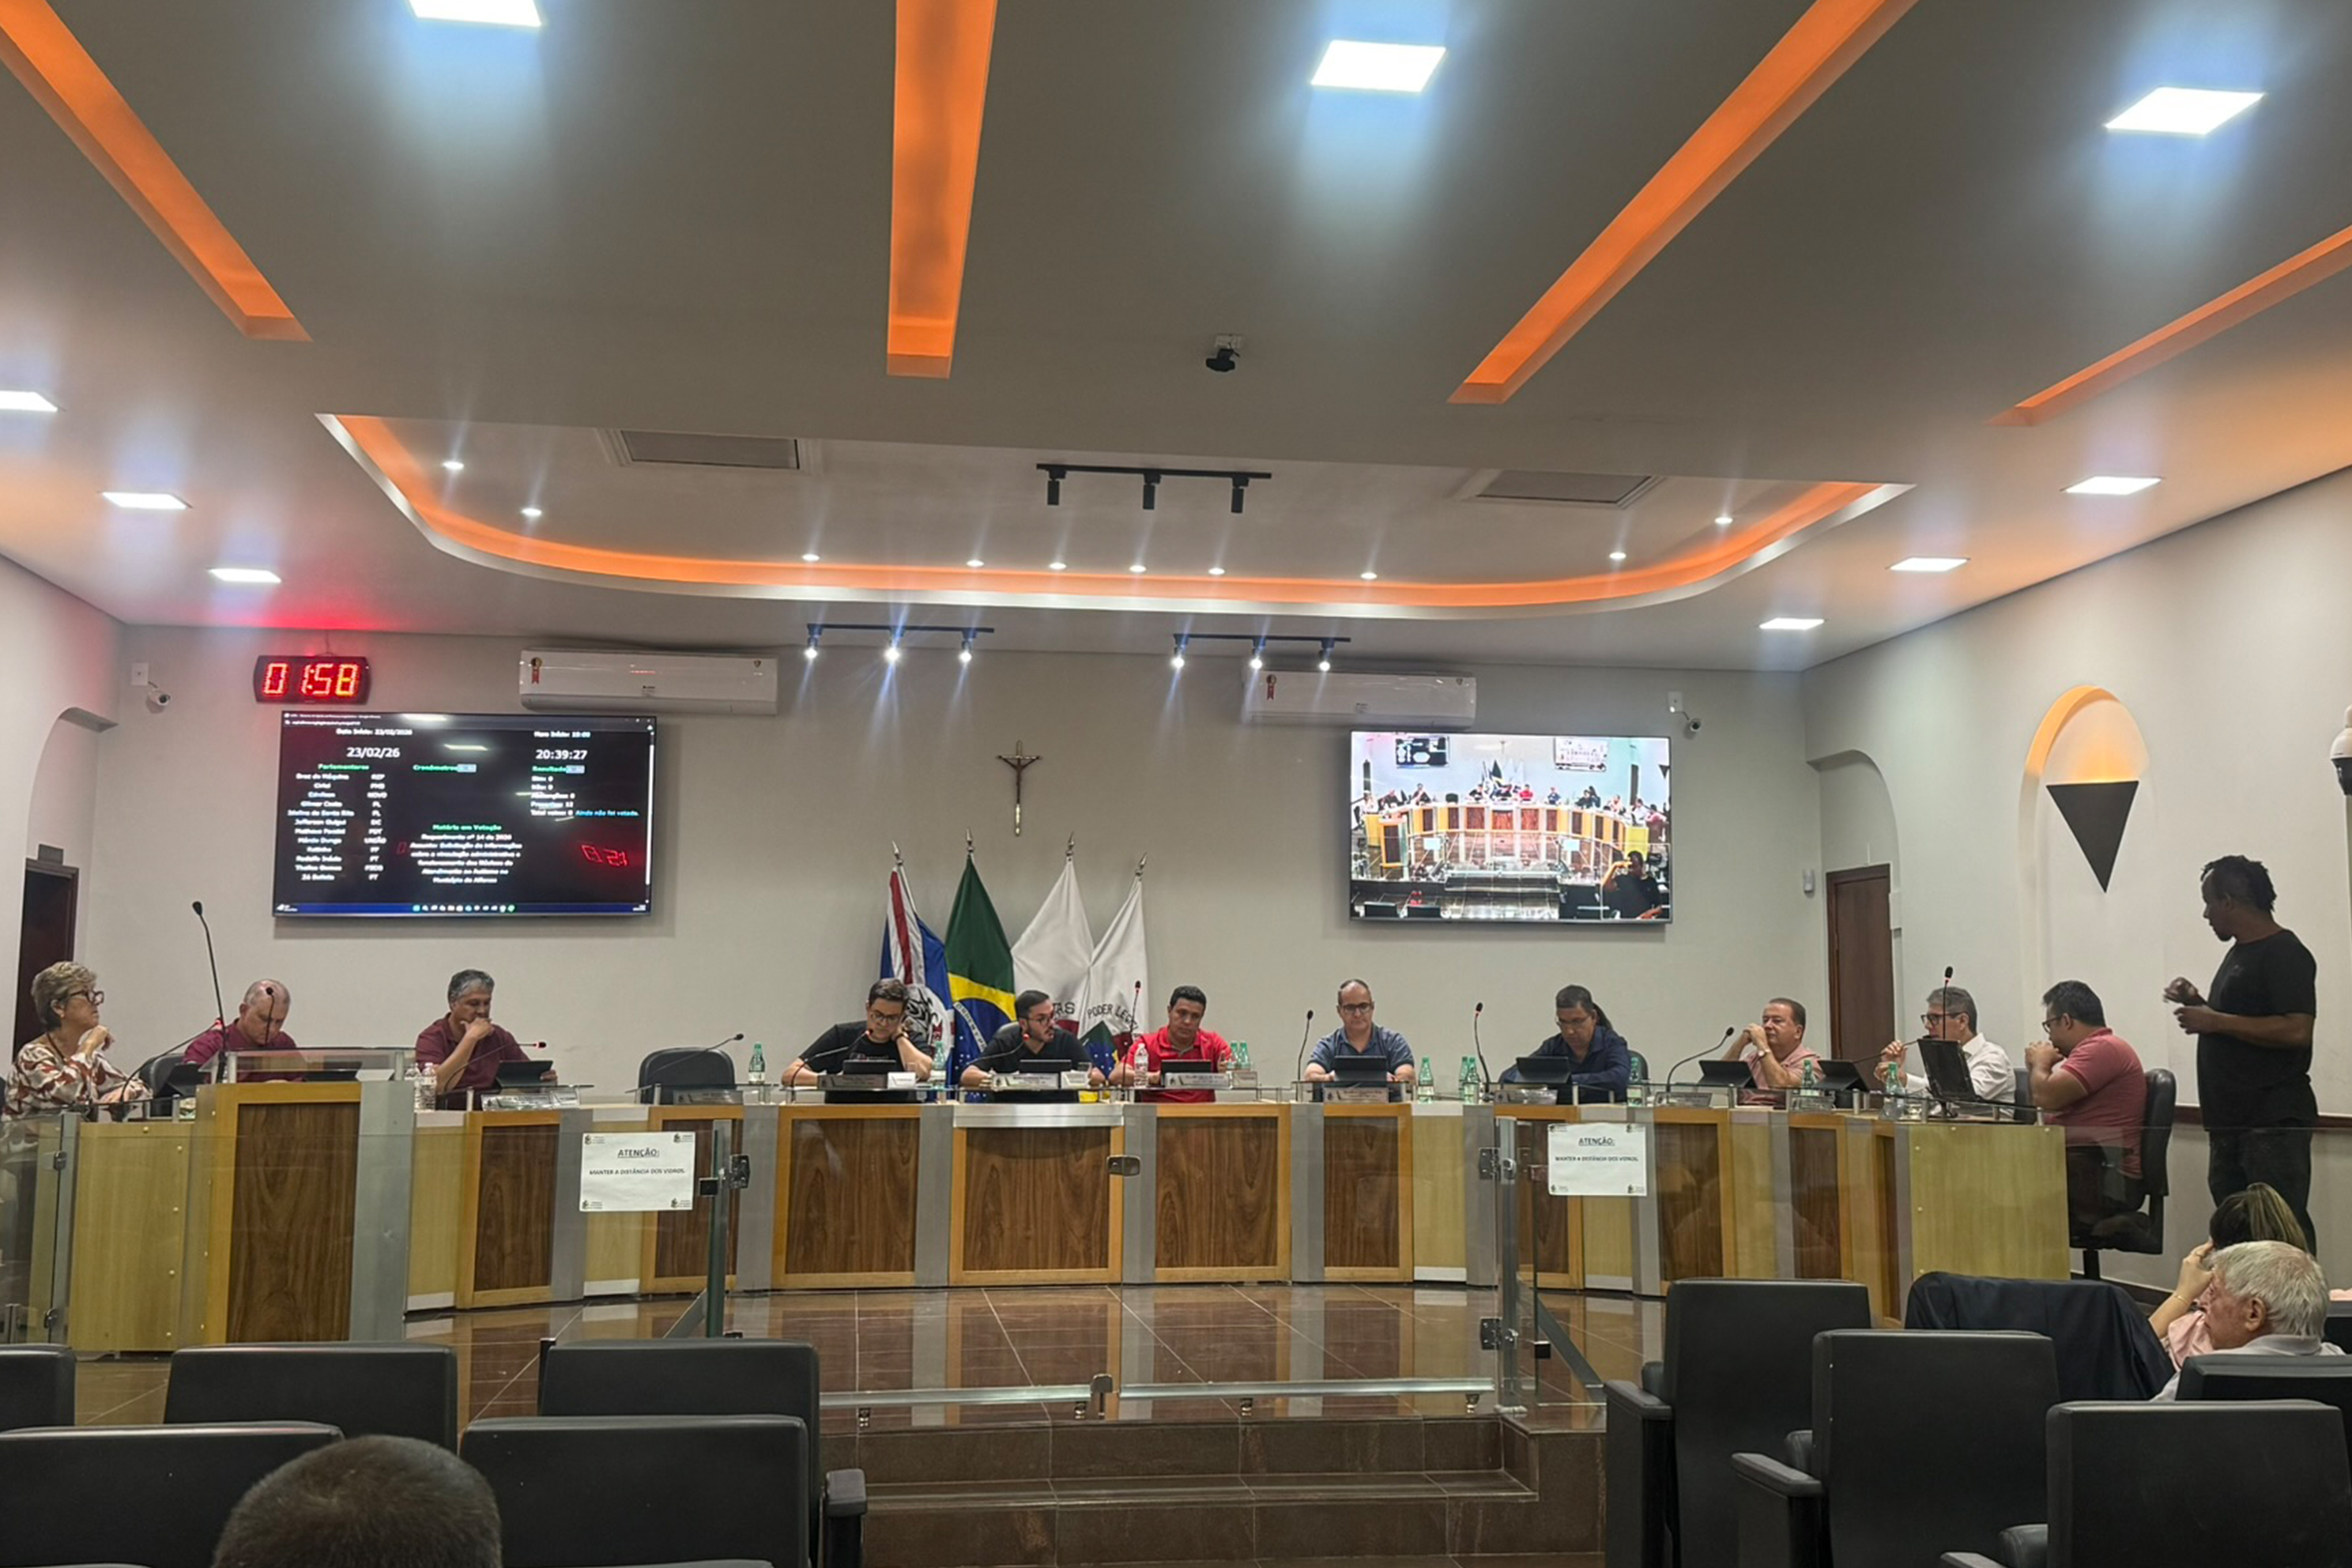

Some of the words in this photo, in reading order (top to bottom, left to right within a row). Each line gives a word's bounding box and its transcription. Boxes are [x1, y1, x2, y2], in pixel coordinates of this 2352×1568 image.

[346, 747, 401, 759] 23/02/26
[535, 749, 588, 760] 20:39:27
[1087, 1003, 1114, 1020] PODER
[1578, 1136, 1615, 1147] ATENÇÃO:
[617, 1148, 660, 1159] ATENÇÃO:
